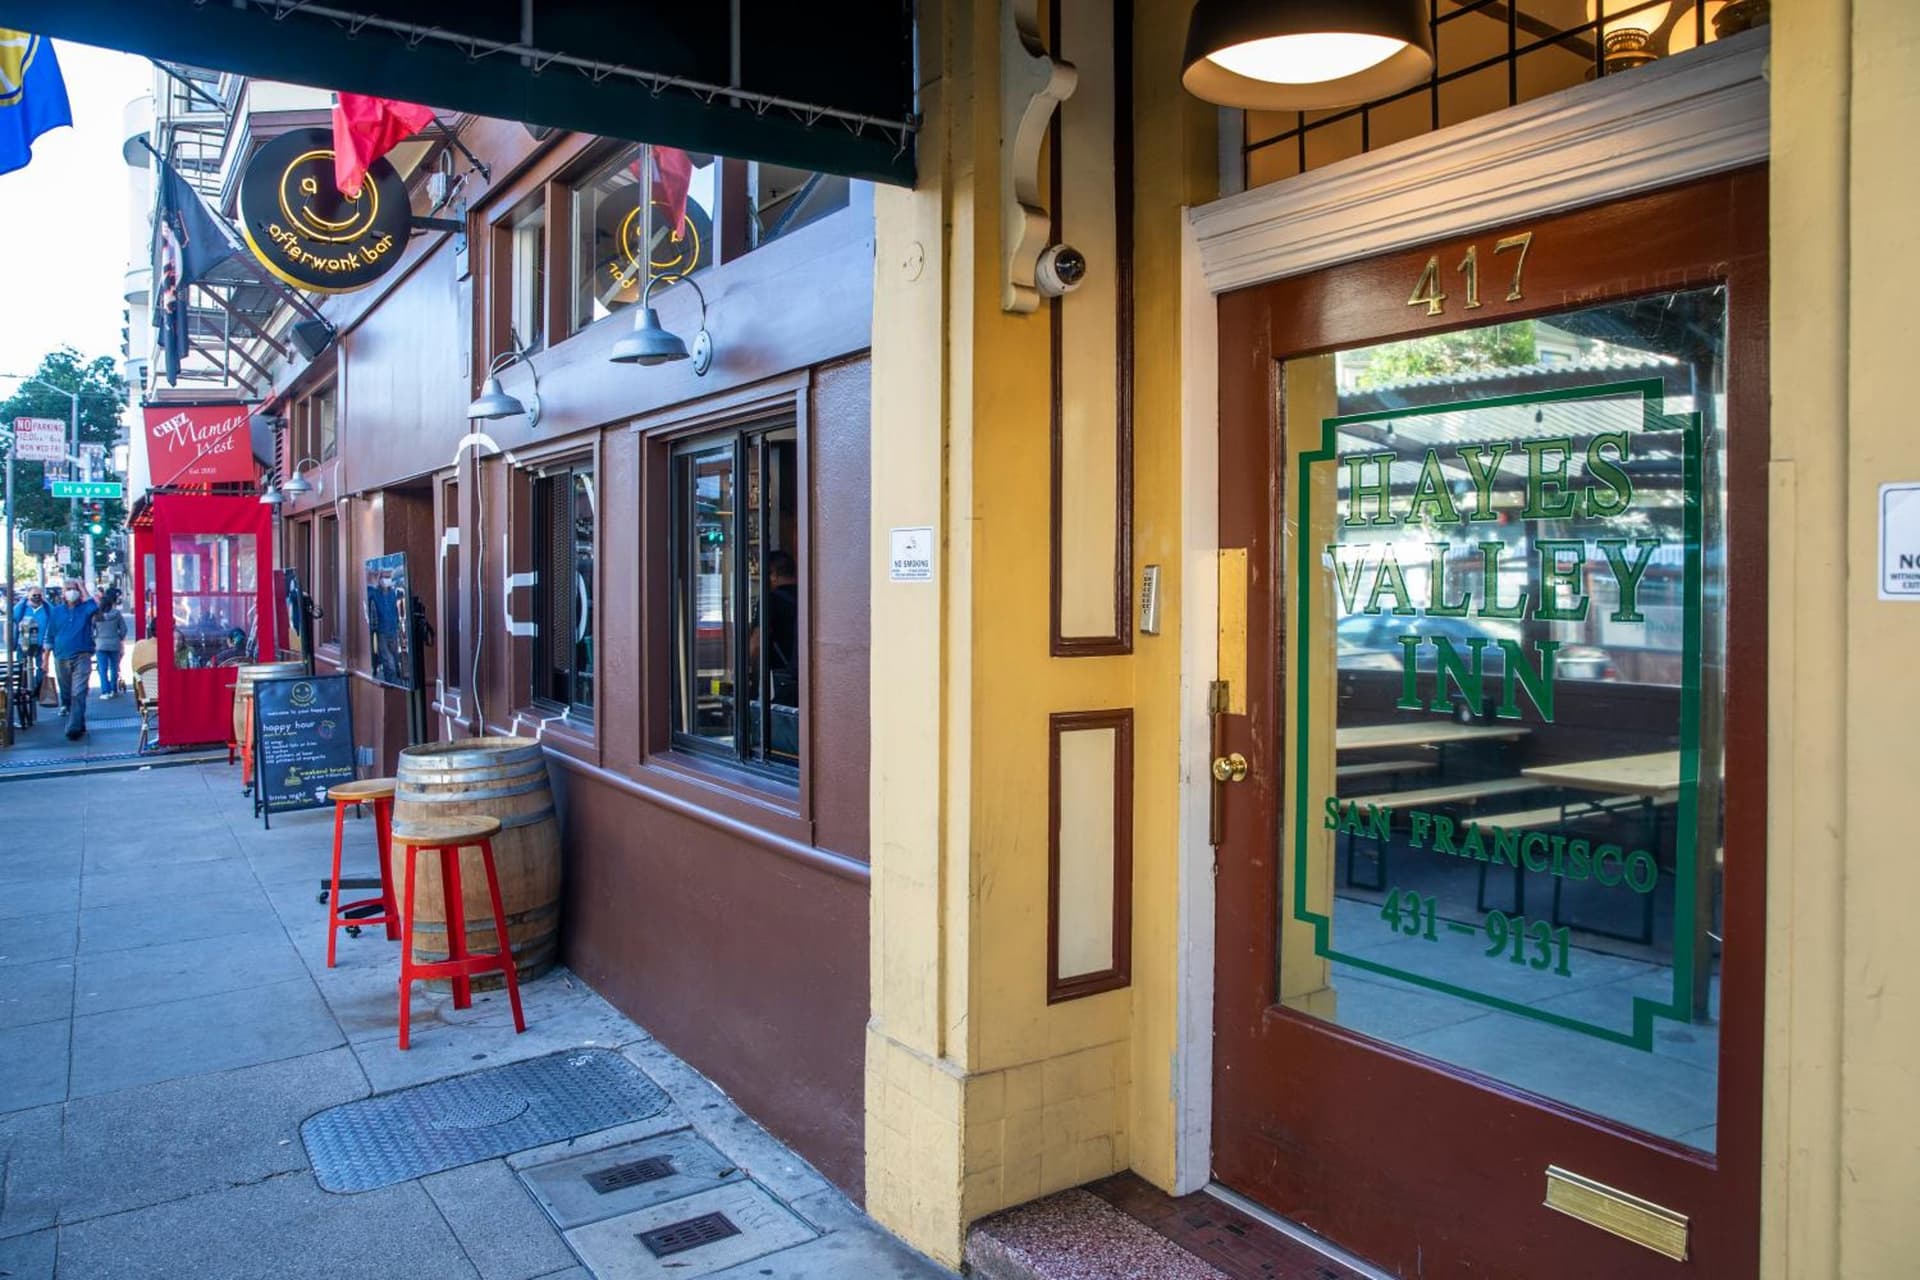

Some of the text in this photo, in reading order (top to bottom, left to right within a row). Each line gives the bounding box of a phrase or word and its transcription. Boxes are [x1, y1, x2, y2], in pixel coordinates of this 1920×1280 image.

[268, 223, 393, 271] afterwork bar
[1407, 231, 1533, 316] 417
[17, 419, 64, 433] NO PARKING
[153, 412, 190, 438] CHEZ
[169, 415, 244, 453] Maman
[197, 435, 235, 457] West
[63, 485, 112, 497] Hayes
[1343, 429, 1634, 527] HAYES
[894, 559, 929, 567] NO SMOKING
[1899, 553, 1920, 569] N
[1326, 537, 1661, 623] VALLEY
[1398, 635, 1560, 724] INN
[263, 720, 315, 734] happy hour
[1324, 796, 1658, 894] SAN FRANCISCO
